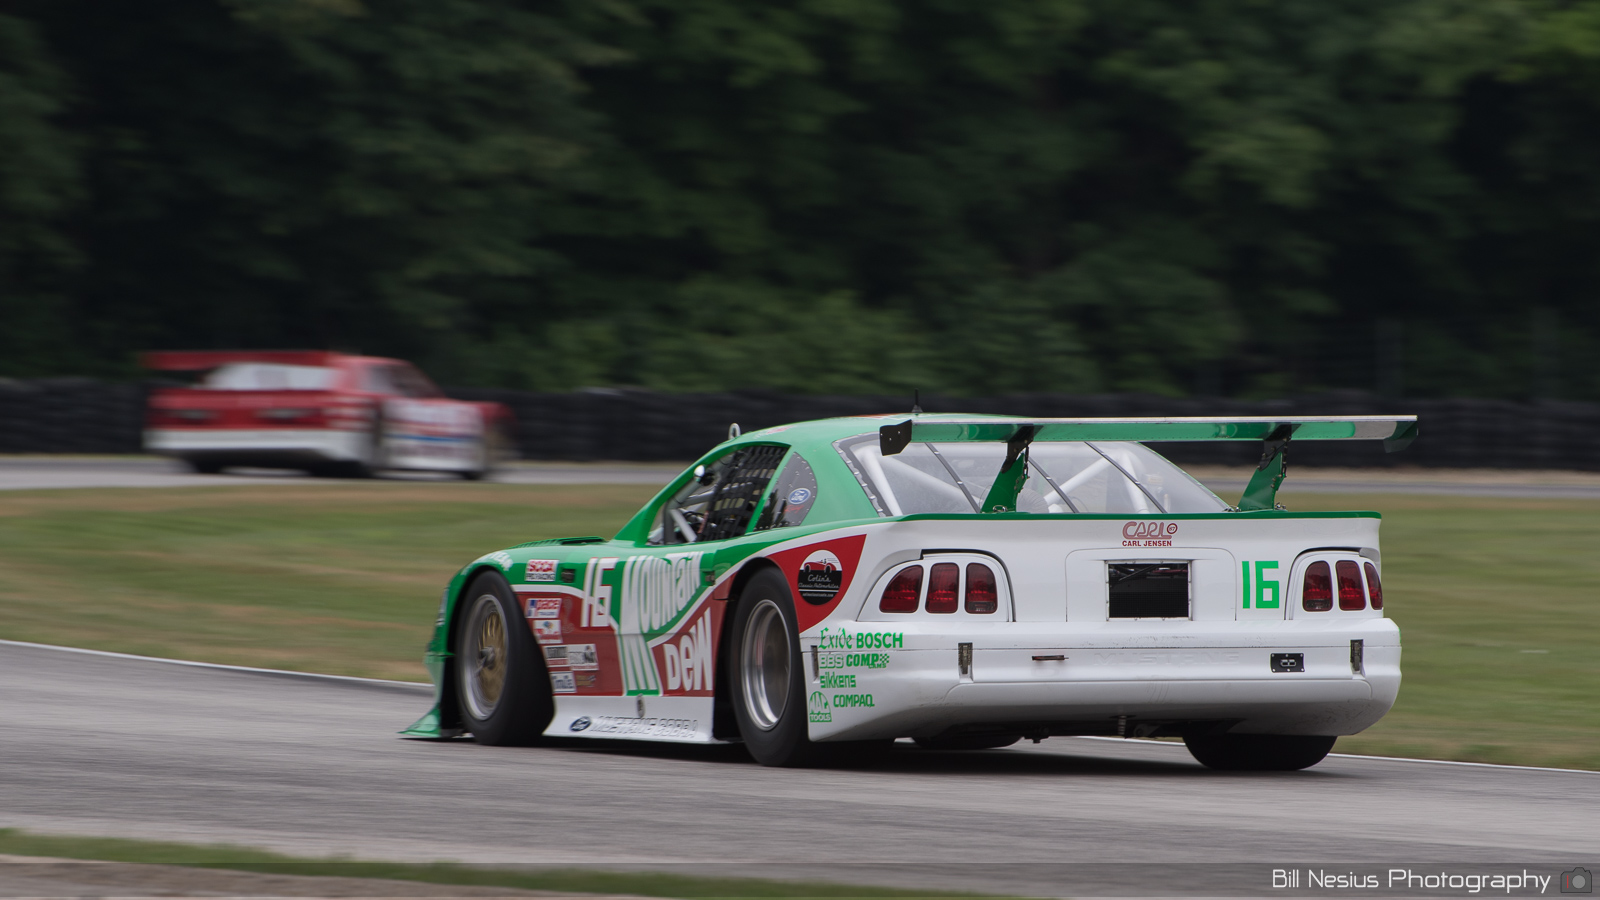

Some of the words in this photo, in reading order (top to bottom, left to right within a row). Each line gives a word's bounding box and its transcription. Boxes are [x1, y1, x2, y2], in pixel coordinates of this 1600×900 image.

[581, 557, 620, 628] 16
[1241, 560, 1280, 609] 16
[818, 627, 853, 650] Exide
[856, 632, 904, 649] BOSCH
[819, 653, 844, 669] BBS
[846, 653, 879, 667] COMP
[833, 693, 876, 709] COMPAQ
